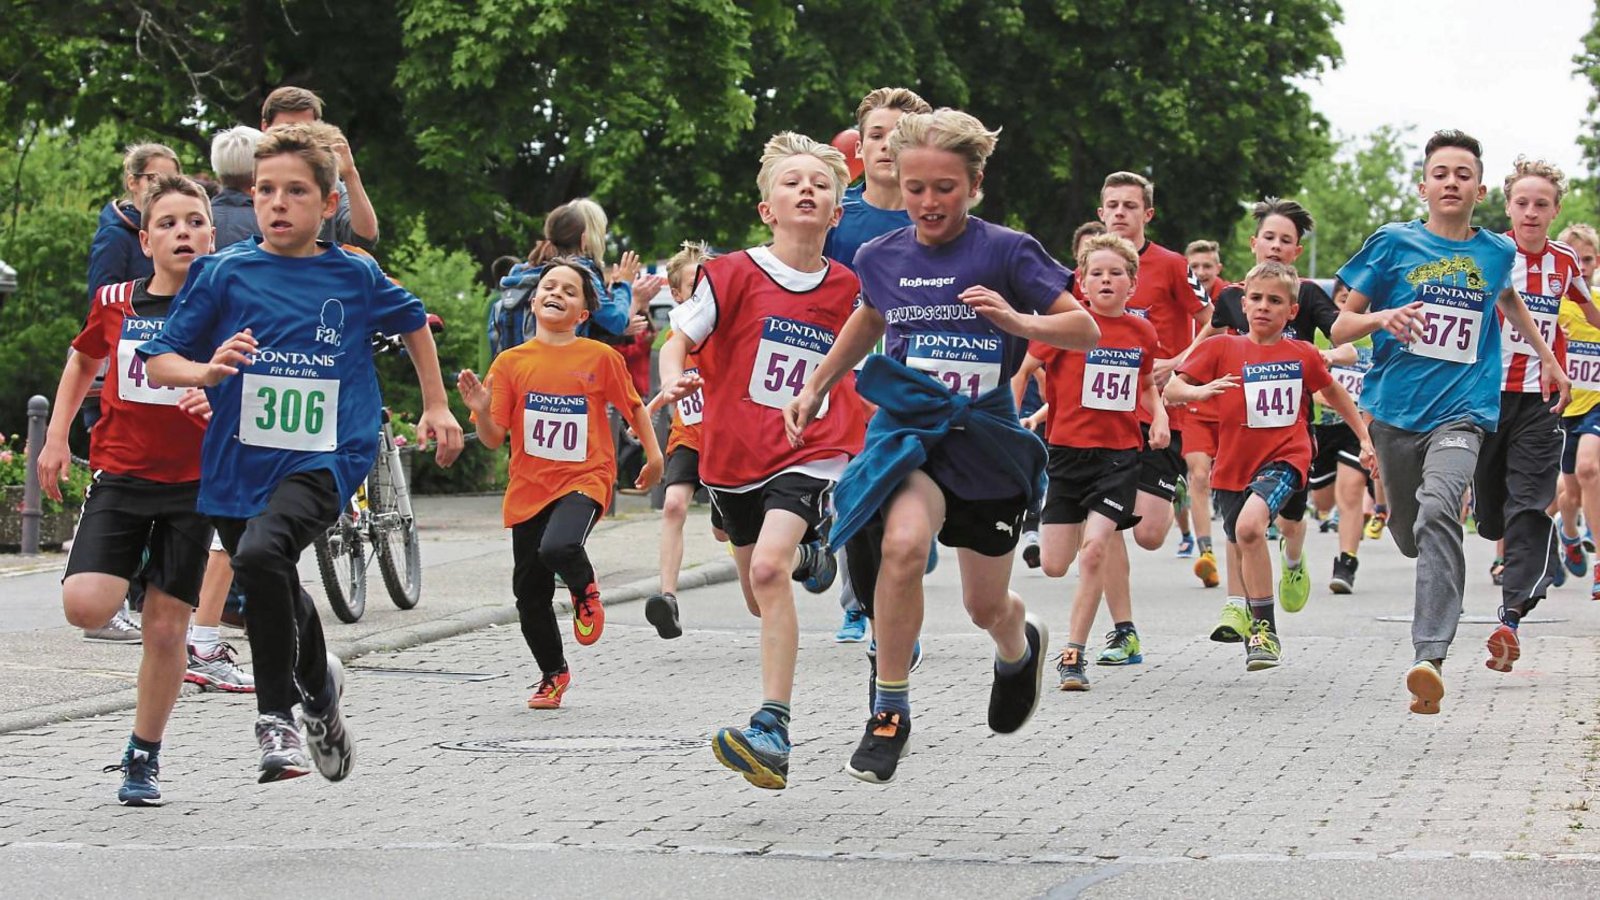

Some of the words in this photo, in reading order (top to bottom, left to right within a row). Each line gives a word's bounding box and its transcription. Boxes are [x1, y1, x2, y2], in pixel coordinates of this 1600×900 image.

[1422, 284, 1484, 302] FONTANIS
[885, 304, 977, 324] GRUNDSCHULE
[126, 320, 165, 333] FONT
[769, 319, 835, 345] FONTANIS
[1421, 312, 1473, 350] 575
[784, 335, 795, 345] Fit
[796, 338, 809, 348] for
[915, 334, 998, 351] FONTANIS
[251, 350, 335, 367] FONTANIS
[931, 349, 943, 358] Fit
[945, 350, 959, 359] for
[1089, 349, 1141, 361] FONTANIS
[269, 366, 283, 376] Fit
[285, 367, 299, 377] for
[764, 352, 819, 397] 54
[1246, 363, 1301, 378] FONTANIS
[1568, 359, 1600, 382] 502
[928, 371, 981, 400] 21
[1091, 371, 1132, 401] 454
[529, 393, 585, 406] FONTANIS
[1256, 387, 1294, 416] 441
[255, 386, 325, 434] 306
[532, 418, 578, 451] 470
